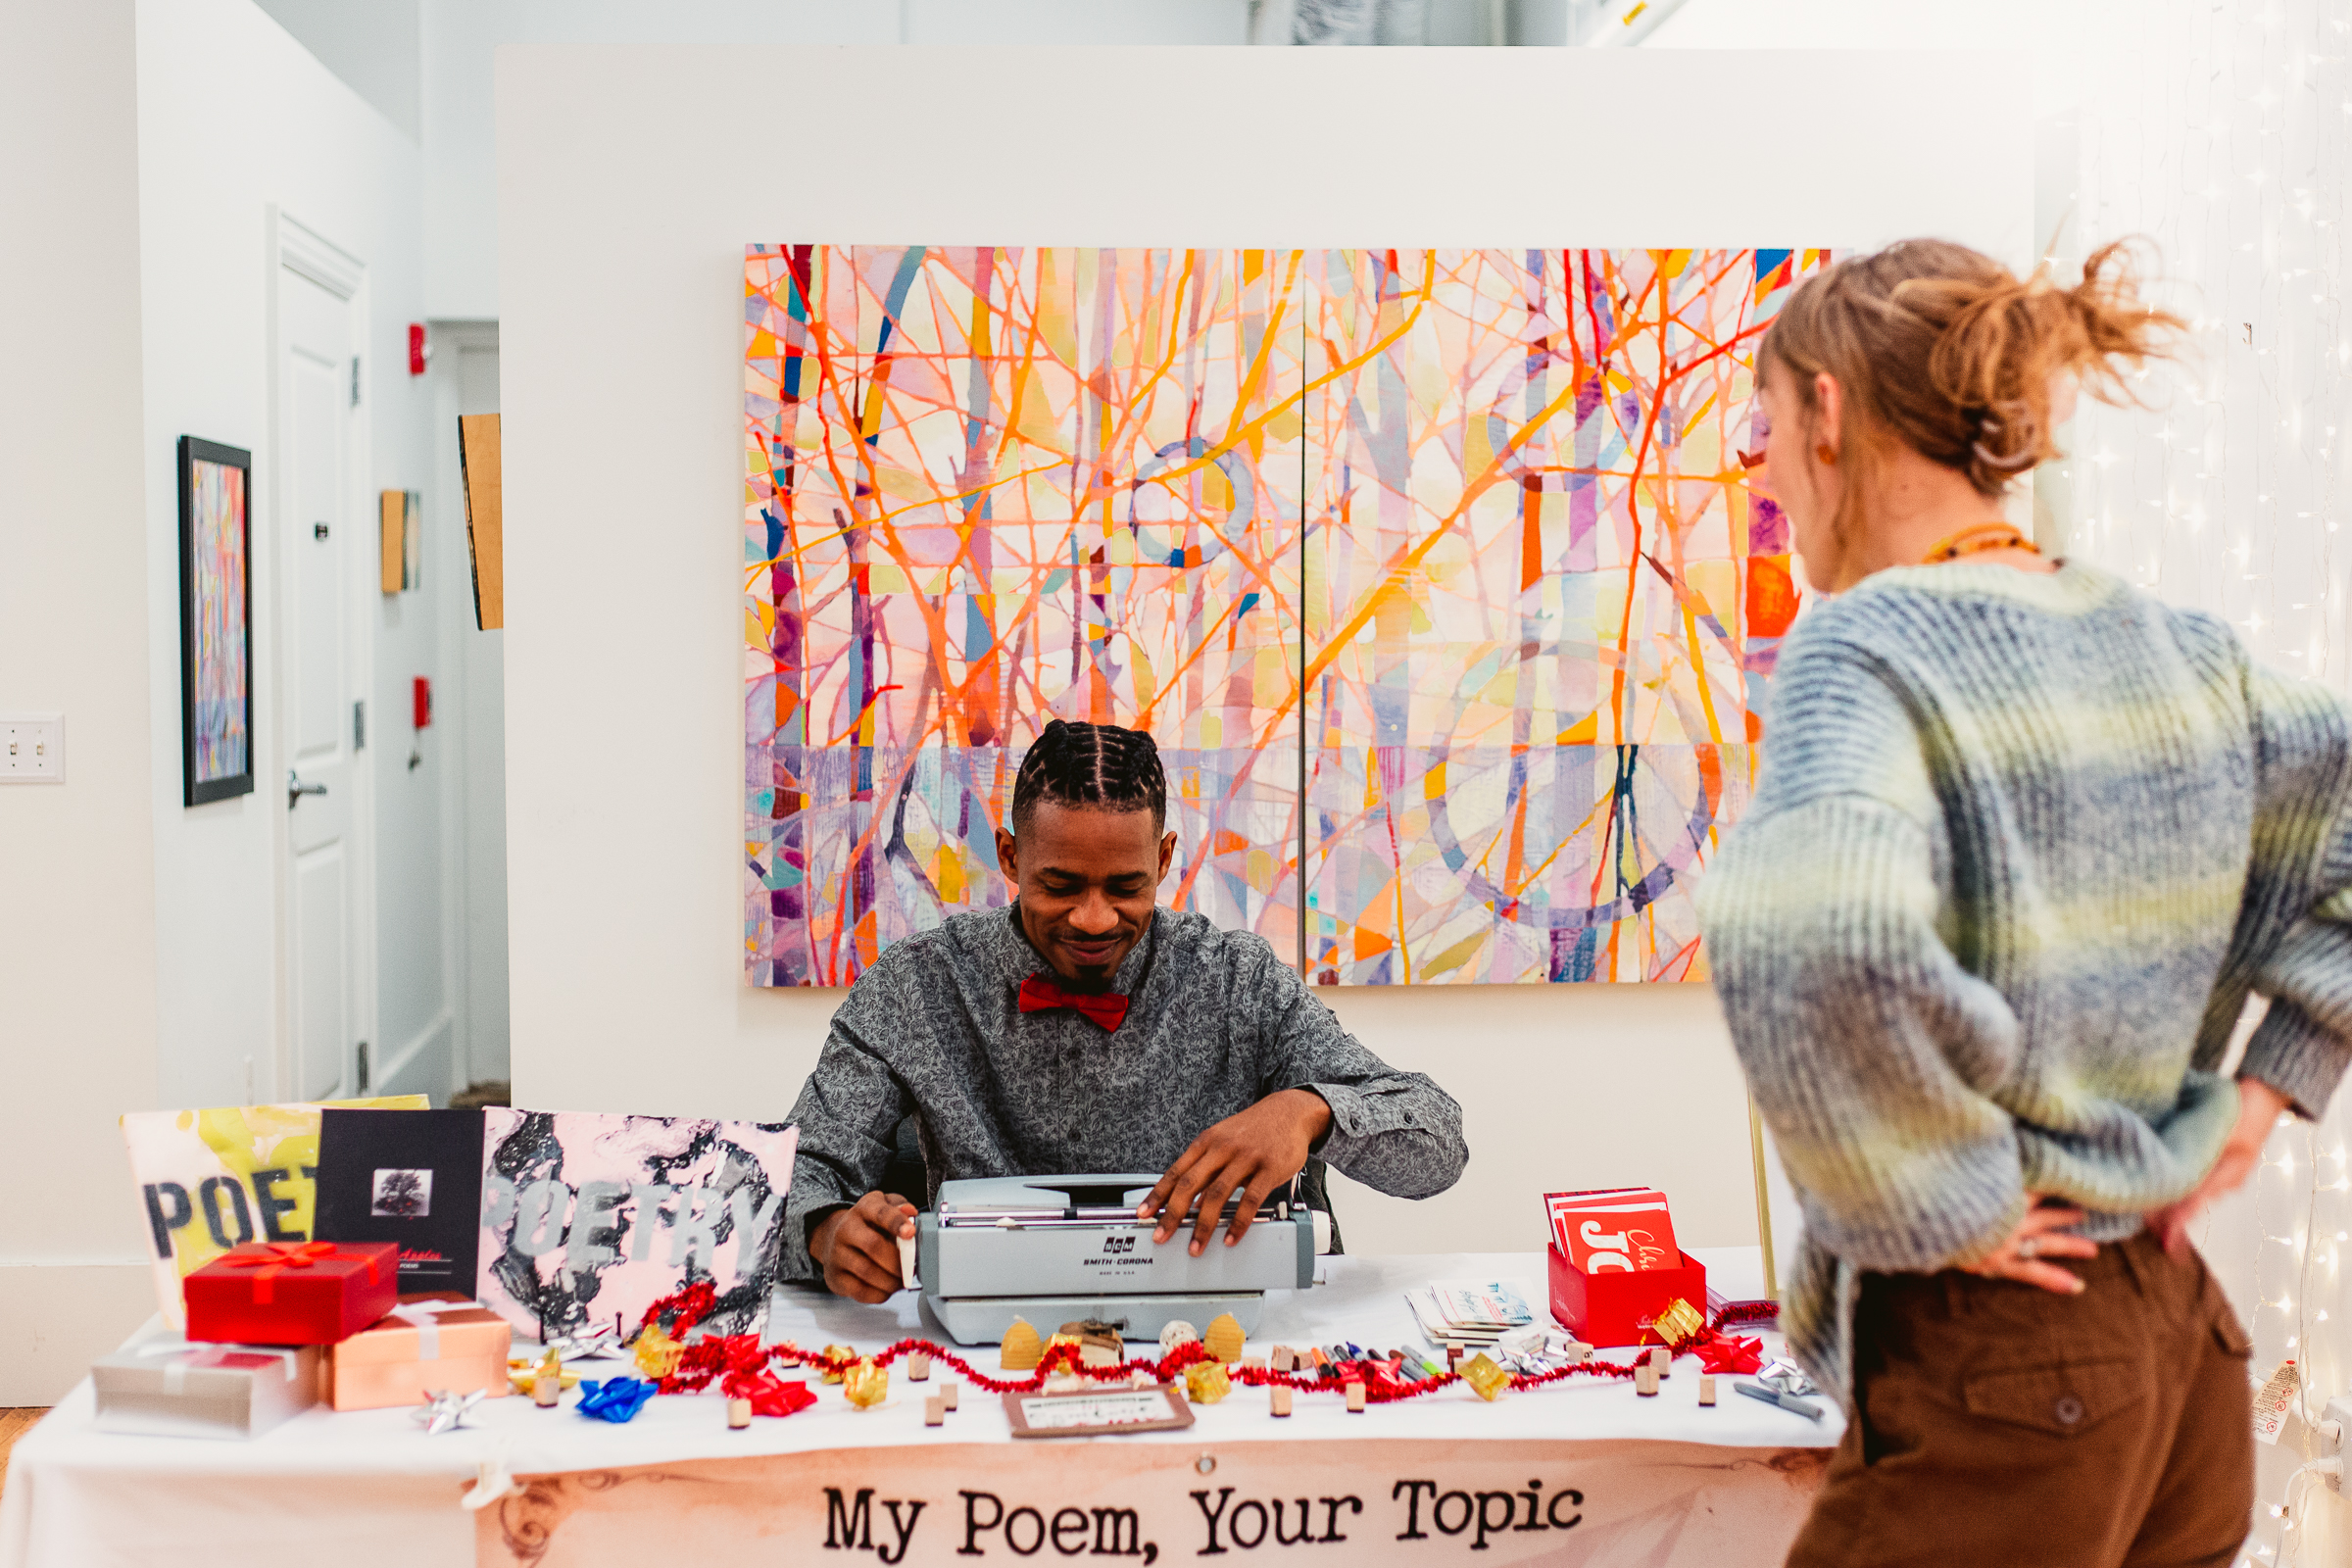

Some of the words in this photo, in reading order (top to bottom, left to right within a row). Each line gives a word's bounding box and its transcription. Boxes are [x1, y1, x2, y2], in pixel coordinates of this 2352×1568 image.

[479, 1176, 782, 1273] POETRY
[821, 1487, 928, 1566] My
[956, 1489, 1160, 1568] Poem,
[1188, 1486, 1364, 1556] Your
[1392, 1478, 1585, 1550] Topic
